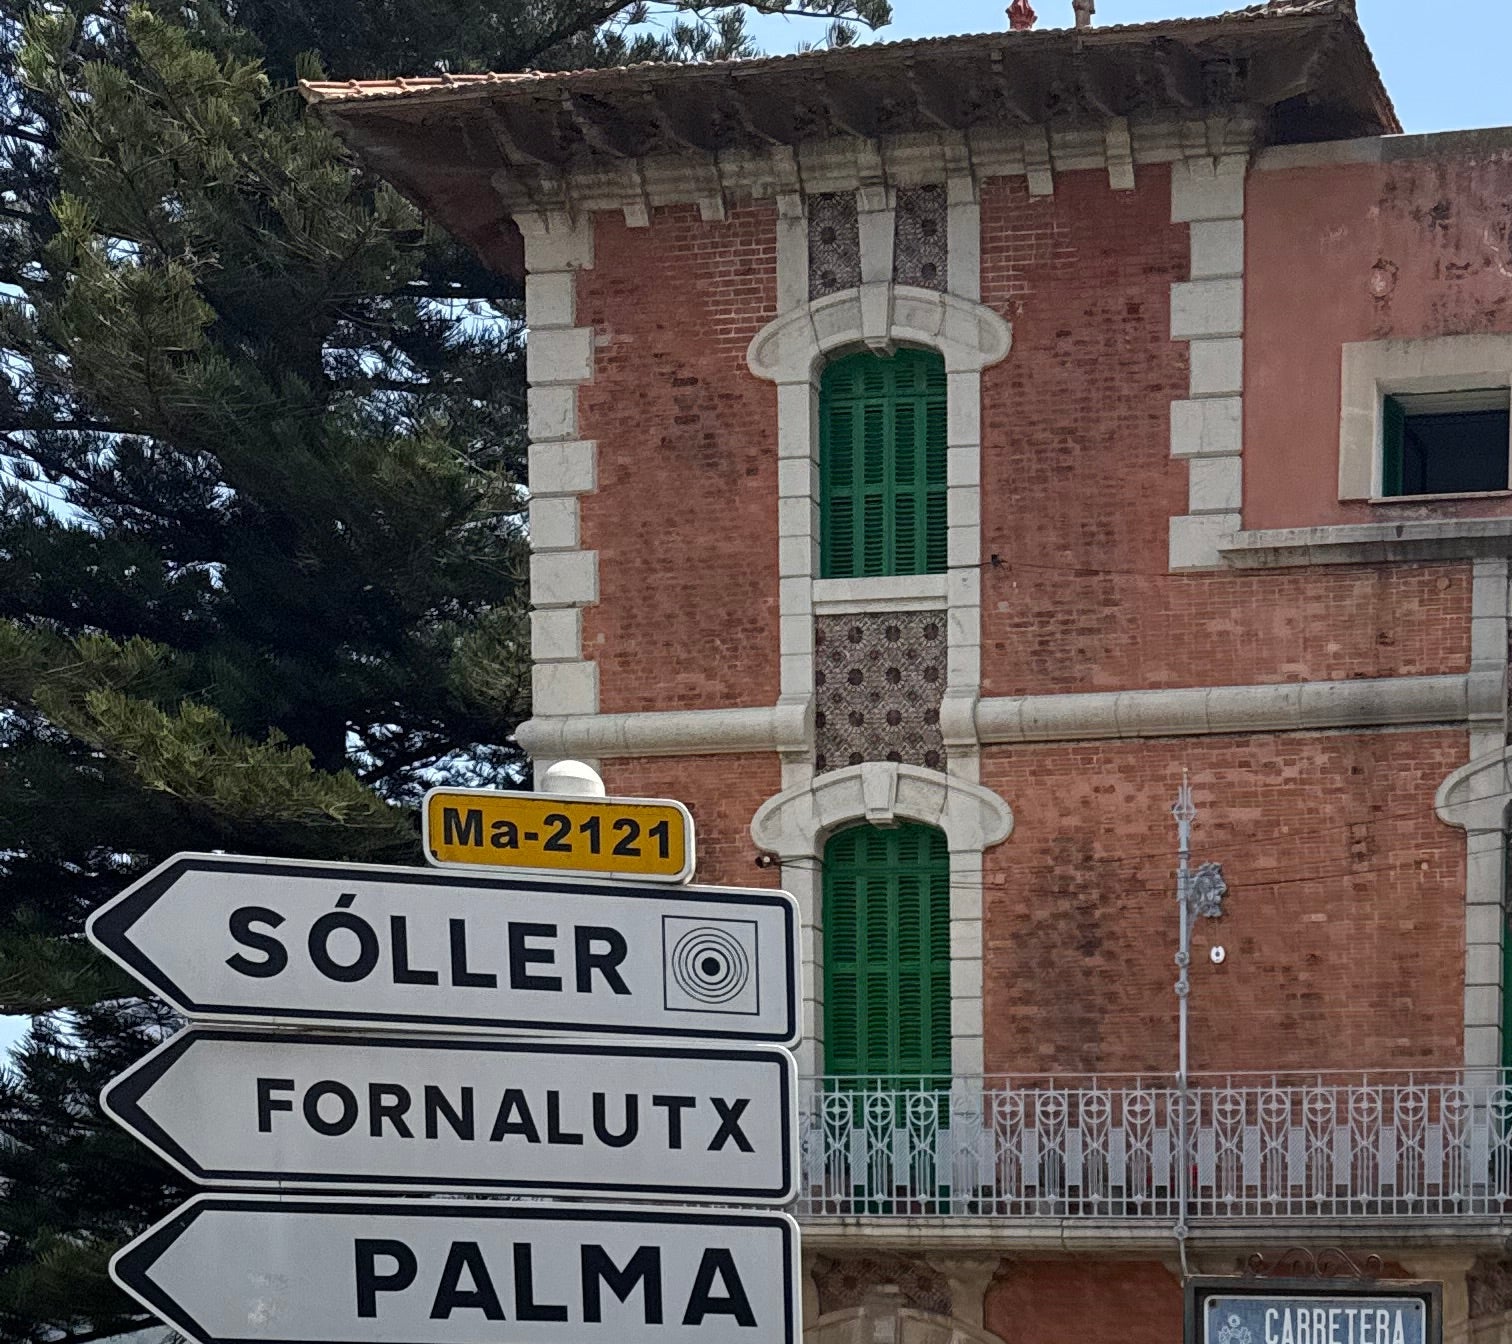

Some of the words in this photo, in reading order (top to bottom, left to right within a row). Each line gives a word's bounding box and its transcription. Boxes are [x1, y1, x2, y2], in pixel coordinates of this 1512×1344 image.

[443, 806, 672, 859] Ma-2121
[225, 893, 633, 996] SÓLLER
[256, 1077, 755, 1153] FORNALUTX
[355, 1238, 757, 1328] PALMA
